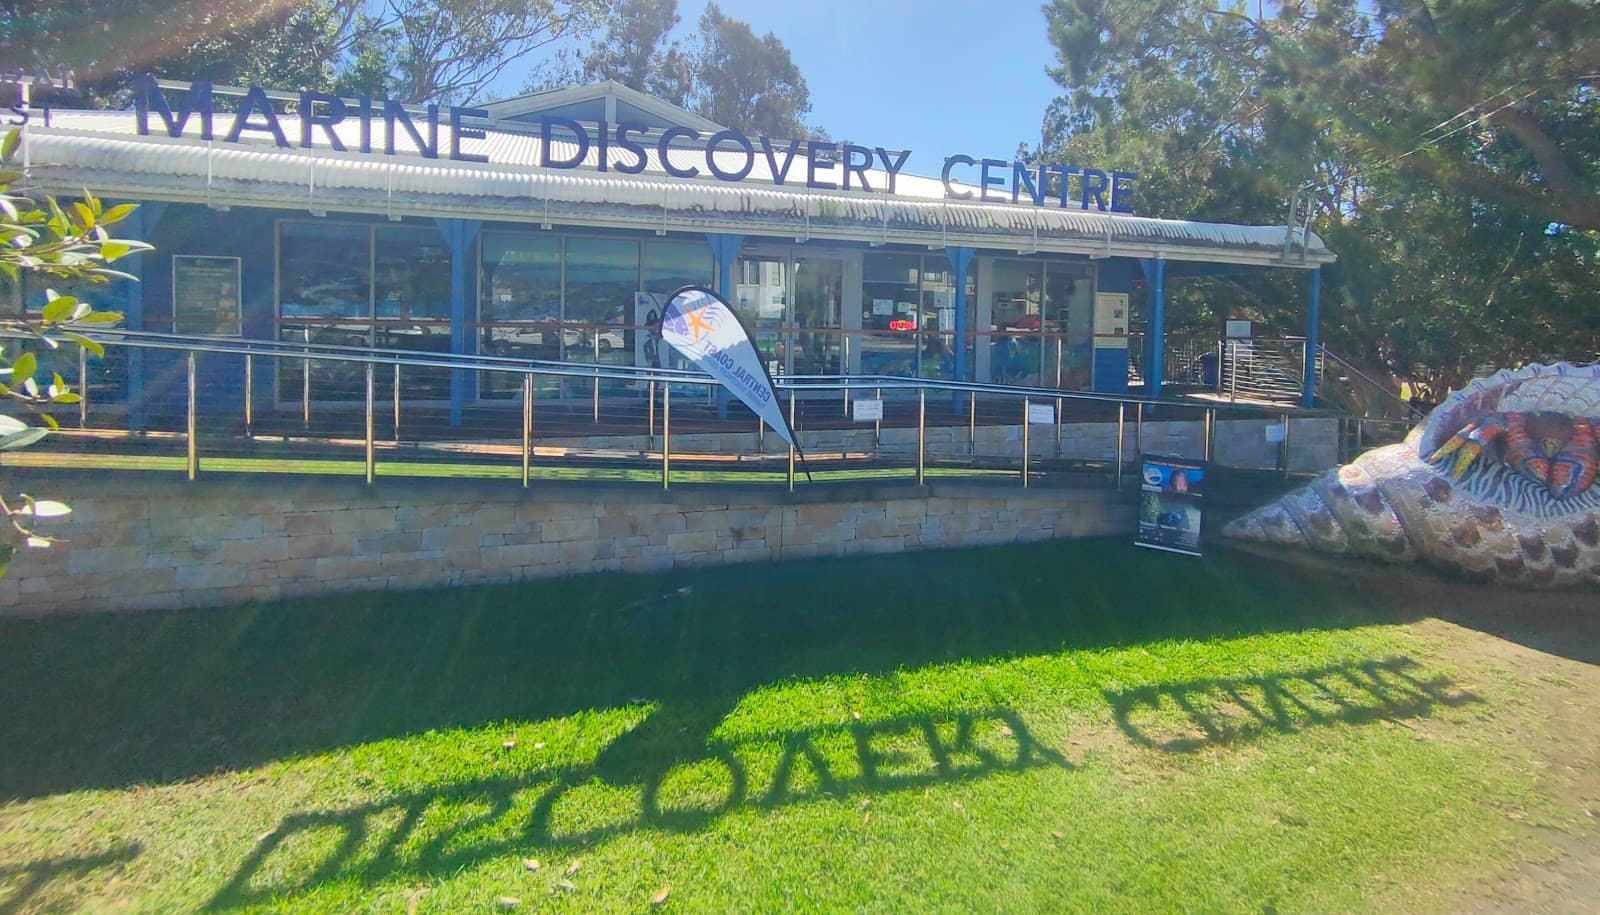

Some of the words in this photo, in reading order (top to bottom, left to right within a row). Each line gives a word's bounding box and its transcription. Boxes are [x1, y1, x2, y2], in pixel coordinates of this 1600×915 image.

[135, 72, 489, 164] MARINE
[541, 116, 912, 194] DISCOVERY
[943, 154, 1137, 214] CENTRE
